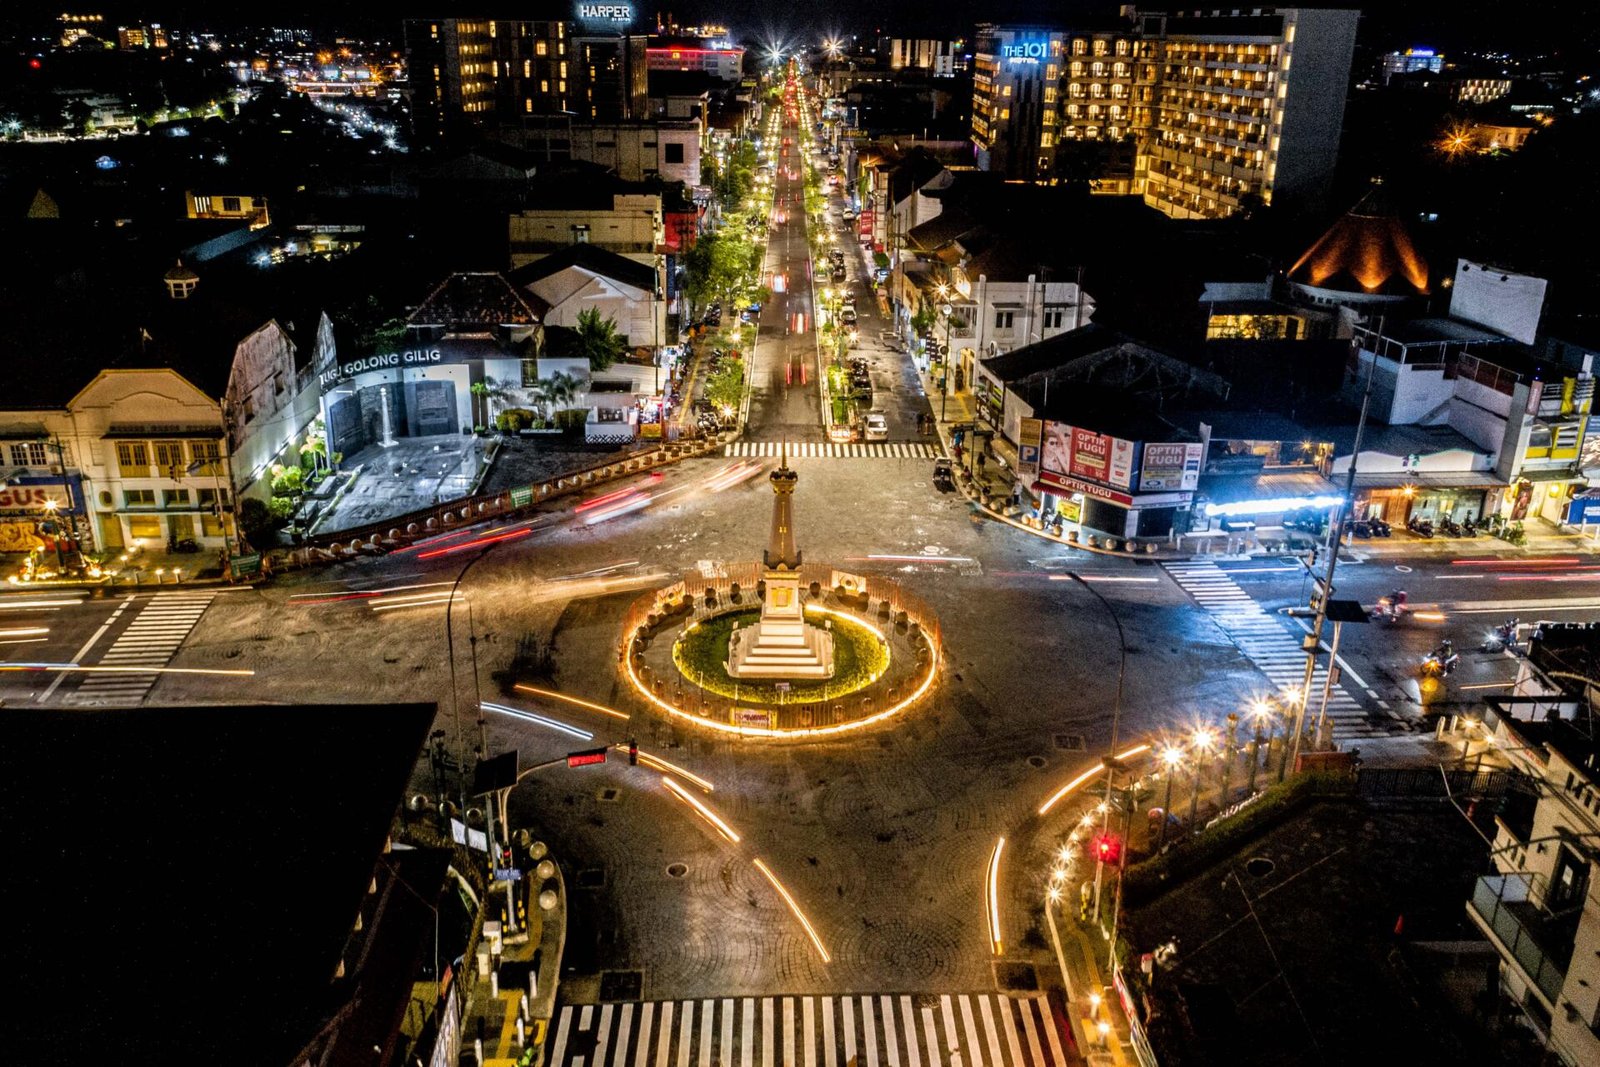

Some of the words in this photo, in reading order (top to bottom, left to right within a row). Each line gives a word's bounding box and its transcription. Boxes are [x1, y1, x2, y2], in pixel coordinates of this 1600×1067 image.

[581, 5, 630, 17] HARPER
[1004, 45, 1023, 57] THE
[1023, 42, 1047, 58] 101
[345, 353, 399, 374] GOLONG
[404, 349, 441, 362] GILIG
[1077, 433, 1106, 446] OPTIK
[1077, 441, 1106, 455] TUGU
[1148, 446, 1184, 455] OPTIK
[1147, 455, 1183, 464] TUGU
[1059, 477, 1086, 491] OPTIK
[1086, 484, 1112, 498] TUGU
